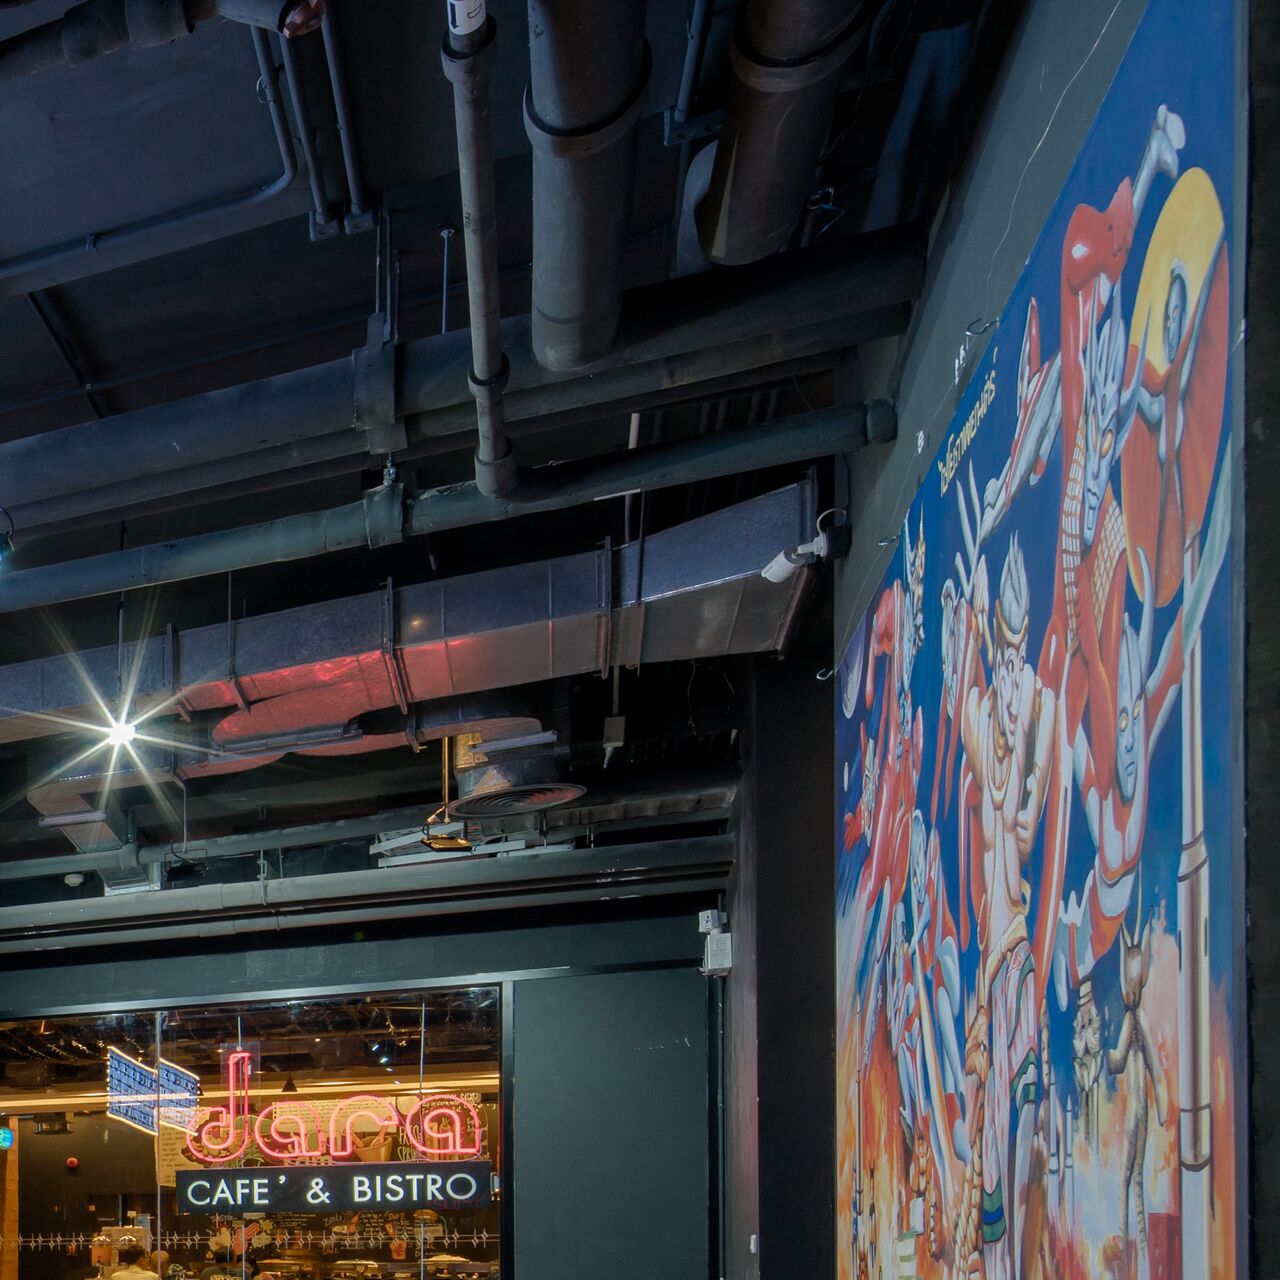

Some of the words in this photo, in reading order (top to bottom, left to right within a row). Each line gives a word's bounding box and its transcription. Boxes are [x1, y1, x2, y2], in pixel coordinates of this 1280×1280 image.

[186, 1052, 481, 1162] dara
[307, 1178, 331, 1204] &
[354, 1173, 477, 1203] BISTRO
